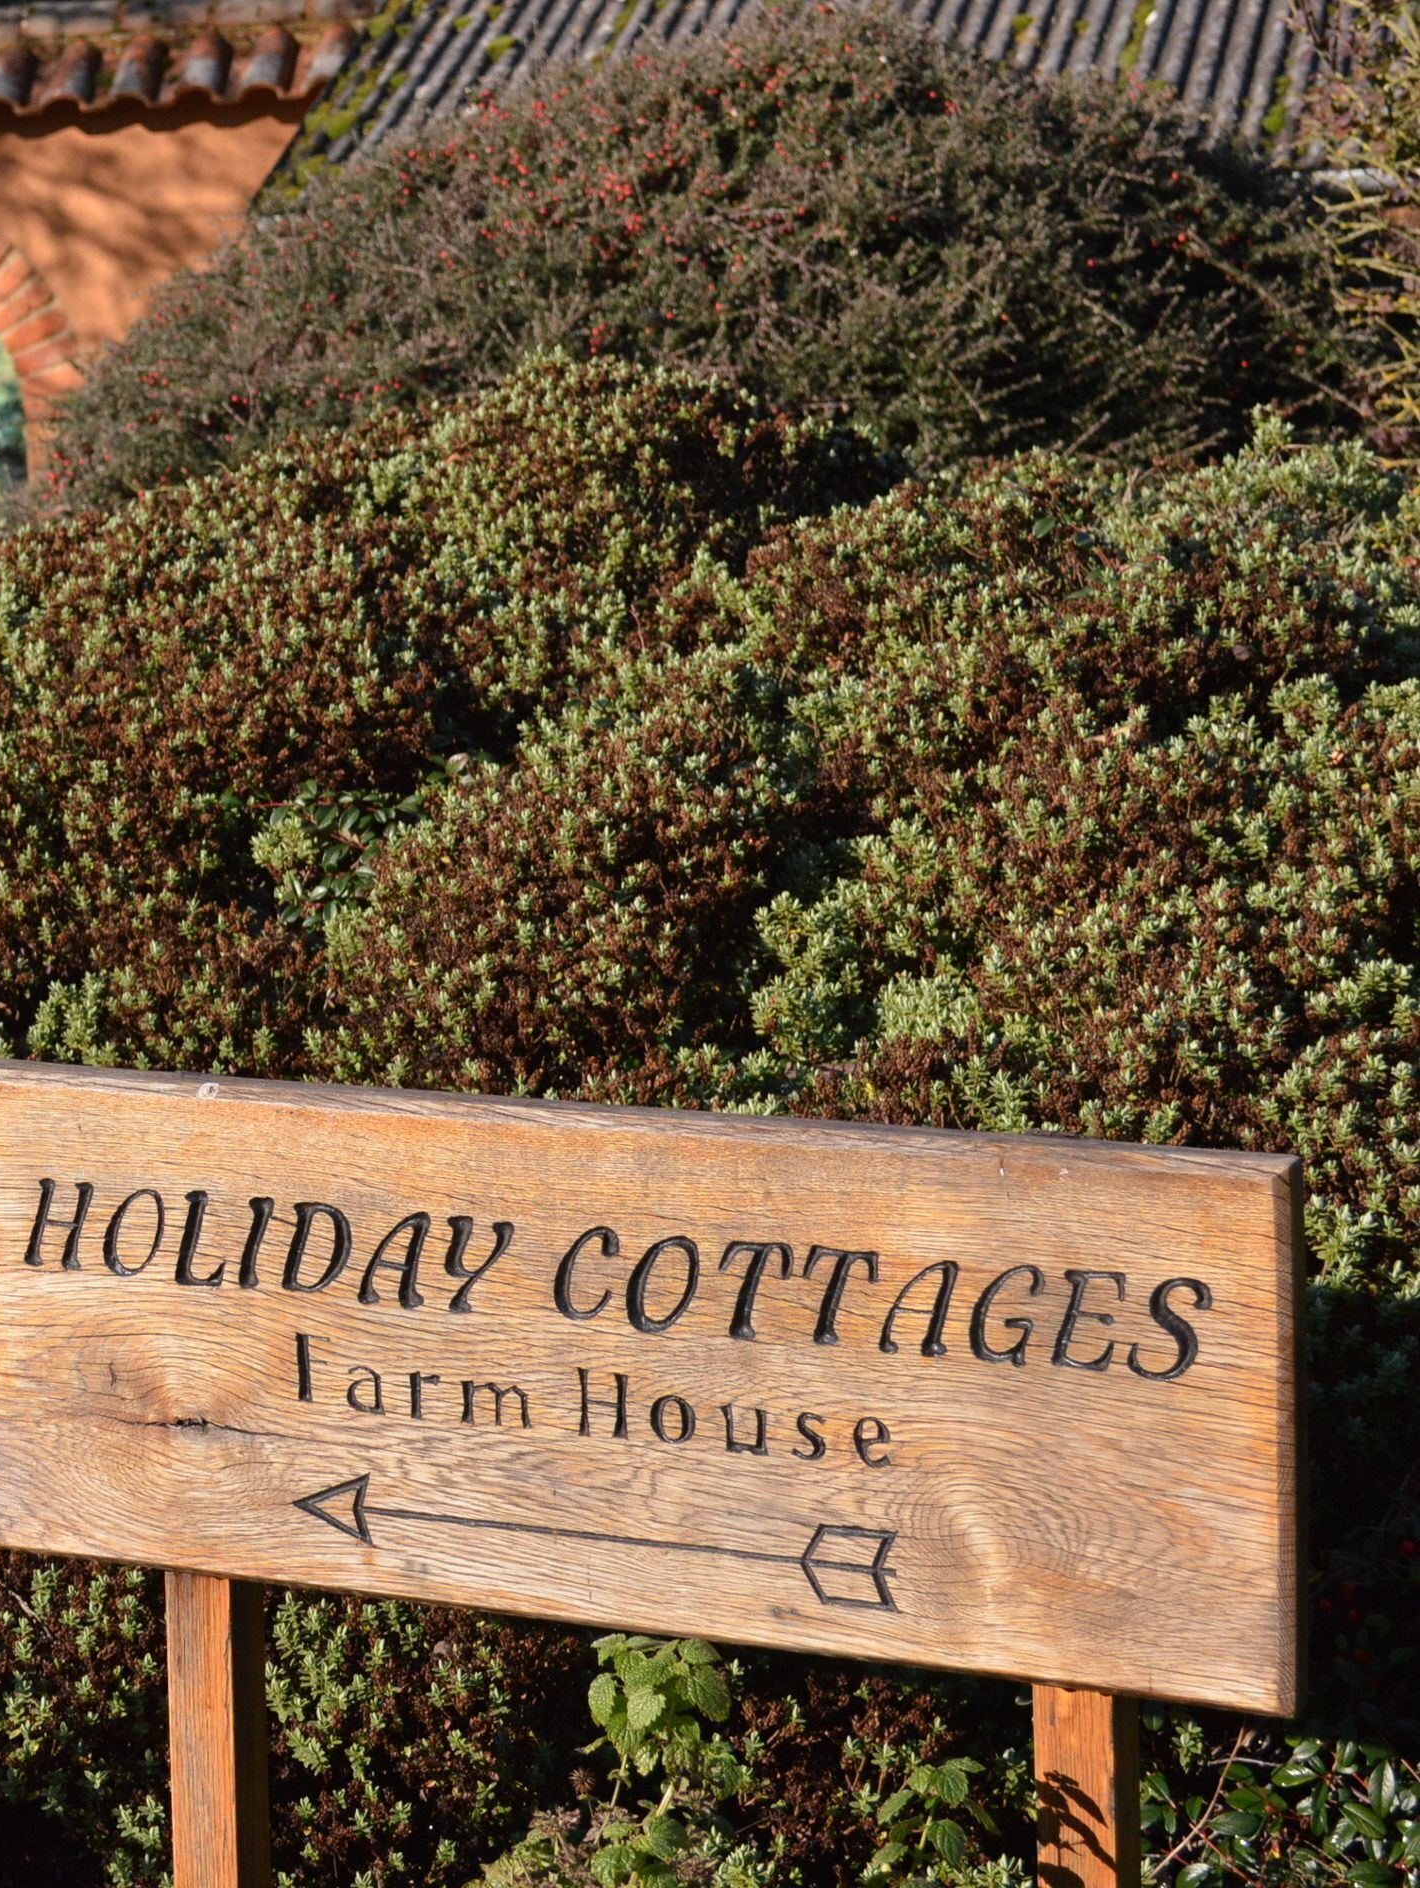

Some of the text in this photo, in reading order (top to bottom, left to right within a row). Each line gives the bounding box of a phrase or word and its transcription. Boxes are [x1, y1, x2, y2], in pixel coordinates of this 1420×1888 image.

[23, 1177, 1213, 1381] HOLIDAY COTTAGES
[294, 1332, 892, 1469] Farm House
